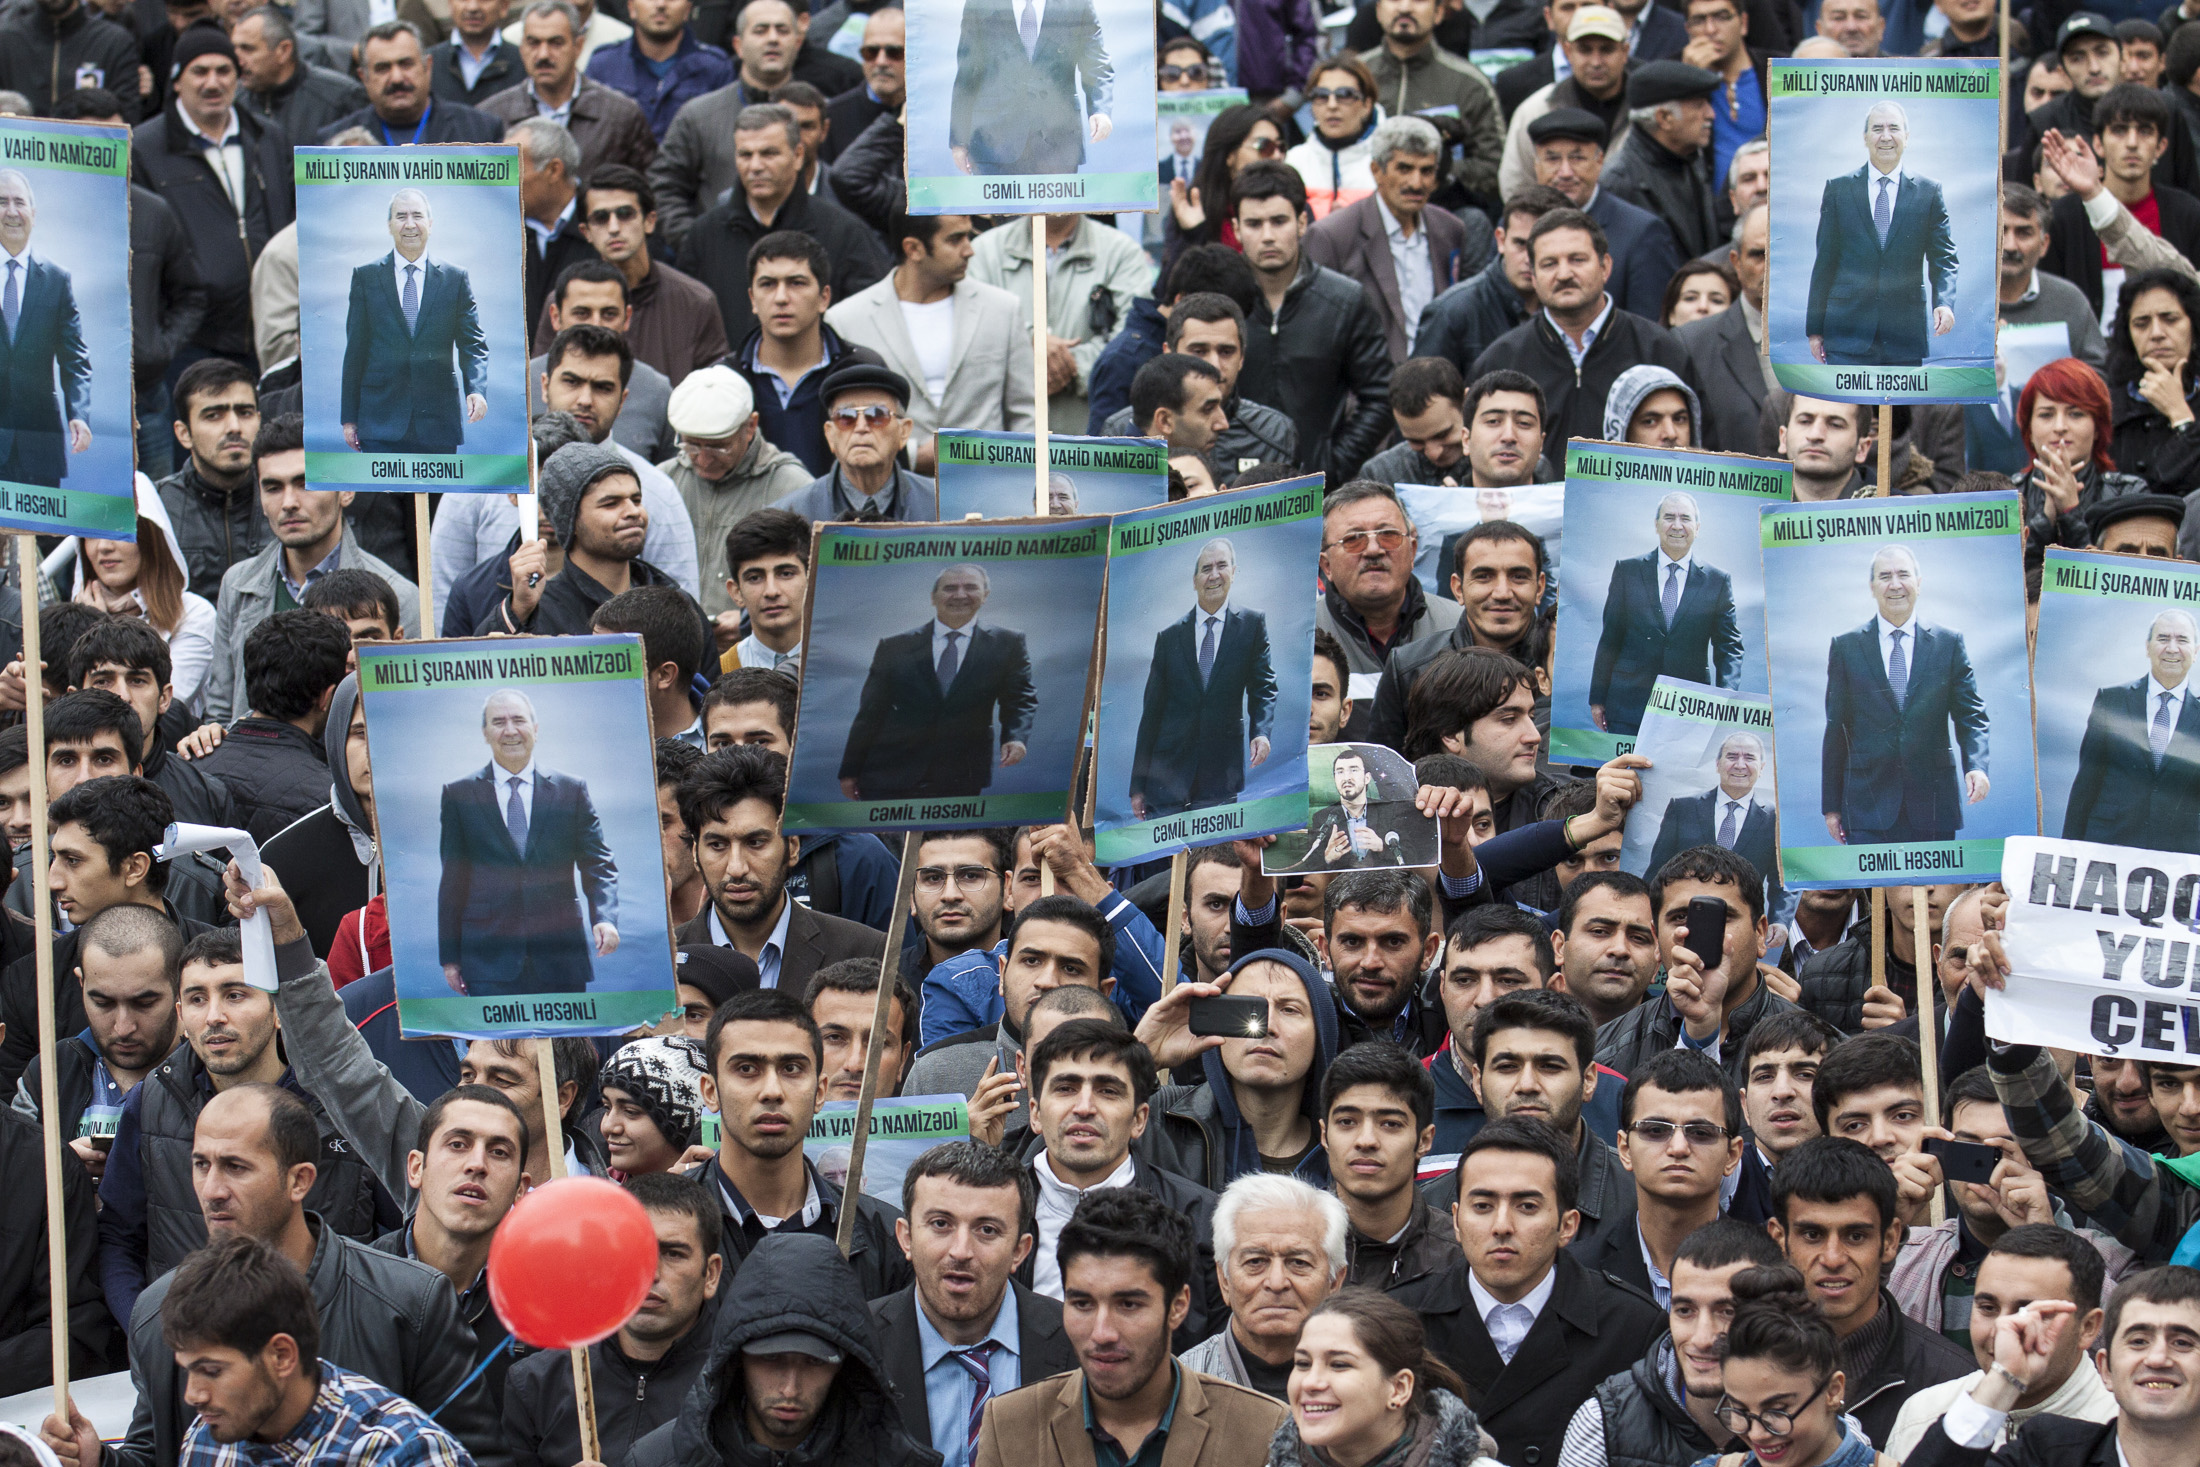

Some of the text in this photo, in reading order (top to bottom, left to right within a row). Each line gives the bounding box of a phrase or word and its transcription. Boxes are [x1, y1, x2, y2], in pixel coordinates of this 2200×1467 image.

[1782, 70, 1990, 95] MİLLİ ŞURANIN VAHİD NAMİZƏDİ
[4, 136, 118, 169] VAHİD NAMİZƏDİ
[305, 158, 510, 183] MİLLİ ŞURANIN VAHİD NAMİZƏDİ
[983, 178, 1085, 200] CƏMİL HƏSƏNLİ
[1835, 371, 1929, 391] CƏMİL HƏSƏNLİ
[371, 458, 464, 479] CƏMİL HƏSƏNLİ
[949, 440, 1159, 470] MİLLİ ŞURANI VAHİD NAMİZƏDİ
[1576, 455, 1784, 494] MİLLİ ŞURANIN VAHİD NAMİZƏDİ
[0, 487, 67, 519] İL HƏSƏNLİ
[1120, 489, 1315, 550] MİLLİ ŞURANIN VAHİD NAMİZƏDİ
[1773, 504, 2009, 542] MİLLİ ŞURANIN VAHİD NAMİZƏDİ
[833, 529, 1097, 563] MİLLİ ŞURANIN VAHİD NAMİZƏDİ
[2055, 565, 2098, 591] MİLLİ
[2100, 572, 2169, 598] ŞURANIN
[374, 648, 633, 687] MİLLİ ŞURANIN VAHİD NAMİZƏDİ
[1678, 695, 1740, 722] ŞURANIN
[1743, 707, 1773, 728] VAH
[868, 799, 987, 822] CƏMİL HƏSƏNLİ
[1153, 807, 1244, 844] CƏMİL HƏSƏNLİ
[1858, 846, 1964, 872] CƏMİL HƏSƏNLİ
[2095, 929, 2200, 993] YU
[482, 998, 597, 1024] CƏMİL HƏSƏNLİ
[882, 1107, 958, 1134] NAMİZƏDİ
